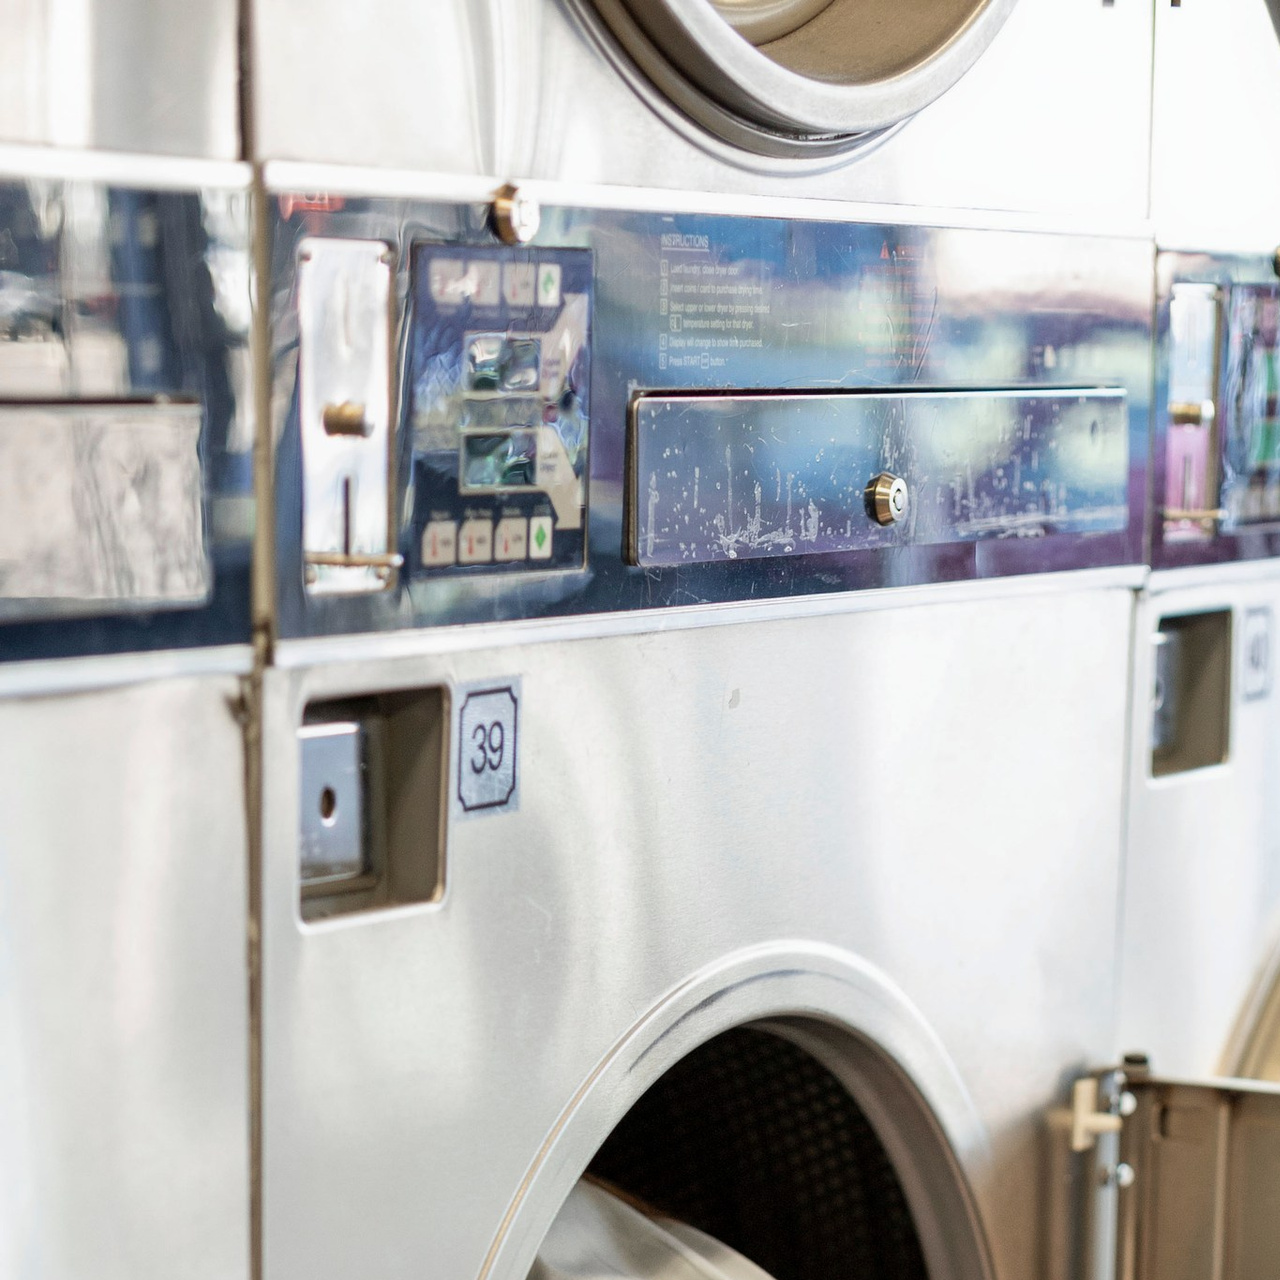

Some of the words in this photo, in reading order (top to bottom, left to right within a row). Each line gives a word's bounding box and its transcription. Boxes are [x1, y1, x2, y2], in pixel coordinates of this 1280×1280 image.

[660, 233, 709, 248] INSTRUCTIONS
[683, 355, 700, 366] START
[471, 721, 504, 774] 39
